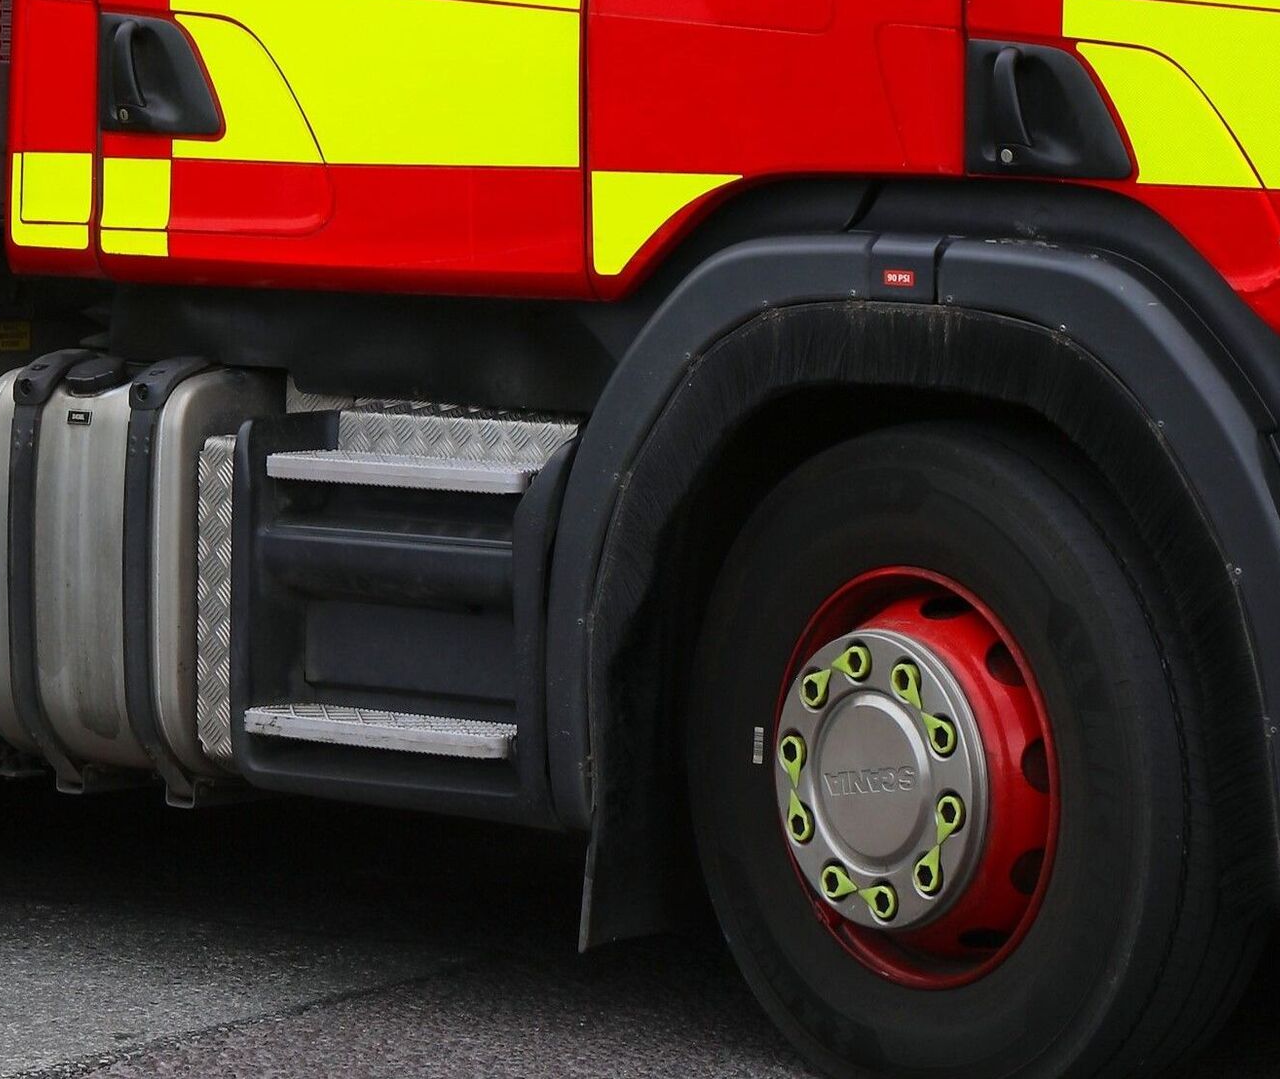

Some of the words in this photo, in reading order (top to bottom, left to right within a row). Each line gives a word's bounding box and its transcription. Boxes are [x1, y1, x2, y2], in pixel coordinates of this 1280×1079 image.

[887, 273, 897, 282] 90
[898, 274, 910, 283] PSI
[823, 766, 916, 798] SCANIA
